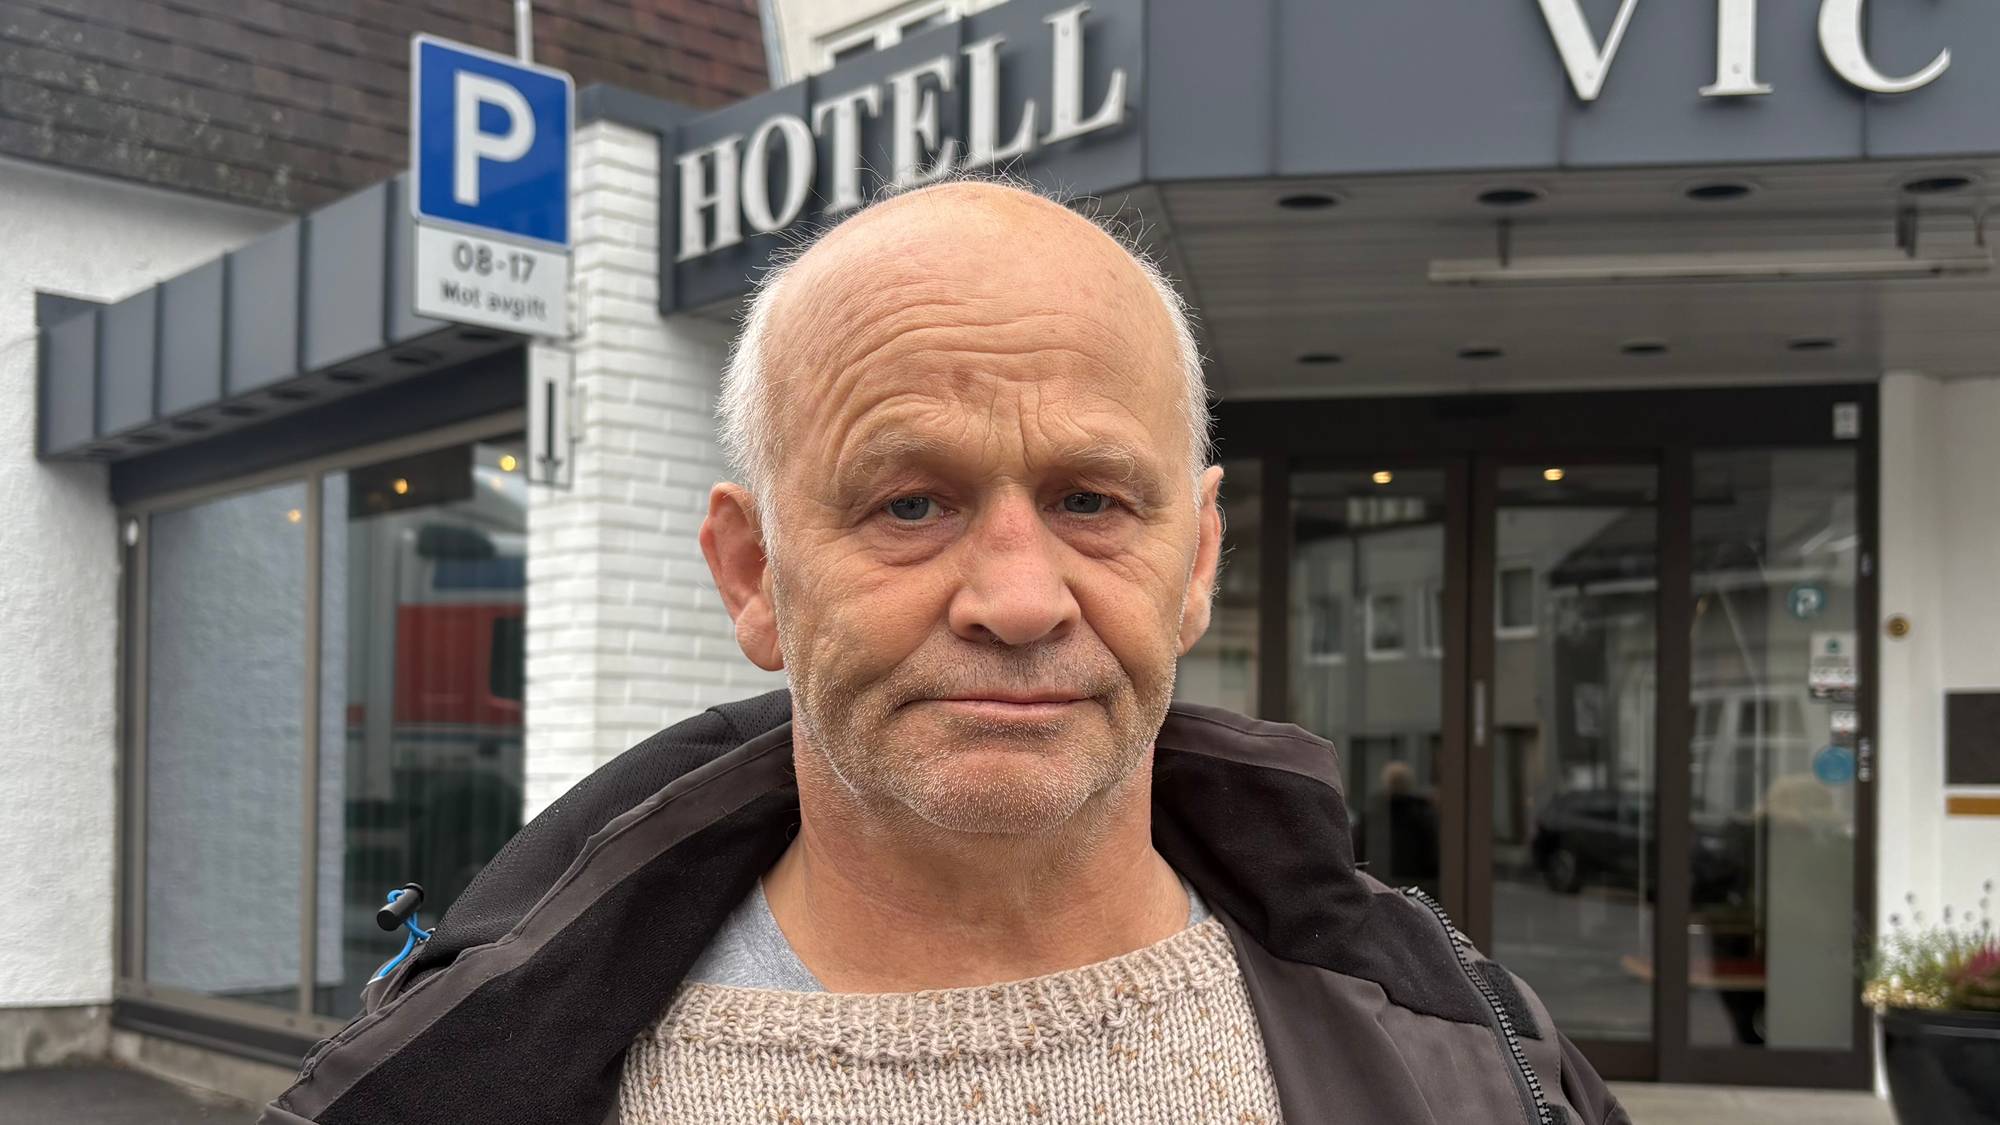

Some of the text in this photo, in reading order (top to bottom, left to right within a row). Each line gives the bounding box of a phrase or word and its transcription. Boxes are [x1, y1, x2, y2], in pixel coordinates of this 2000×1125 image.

[454, 71, 535, 205] P
[676, 3, 1127, 262] HOTELL
[440, 279, 480, 309] Mot
[452, 240, 536, 283] 08-17
